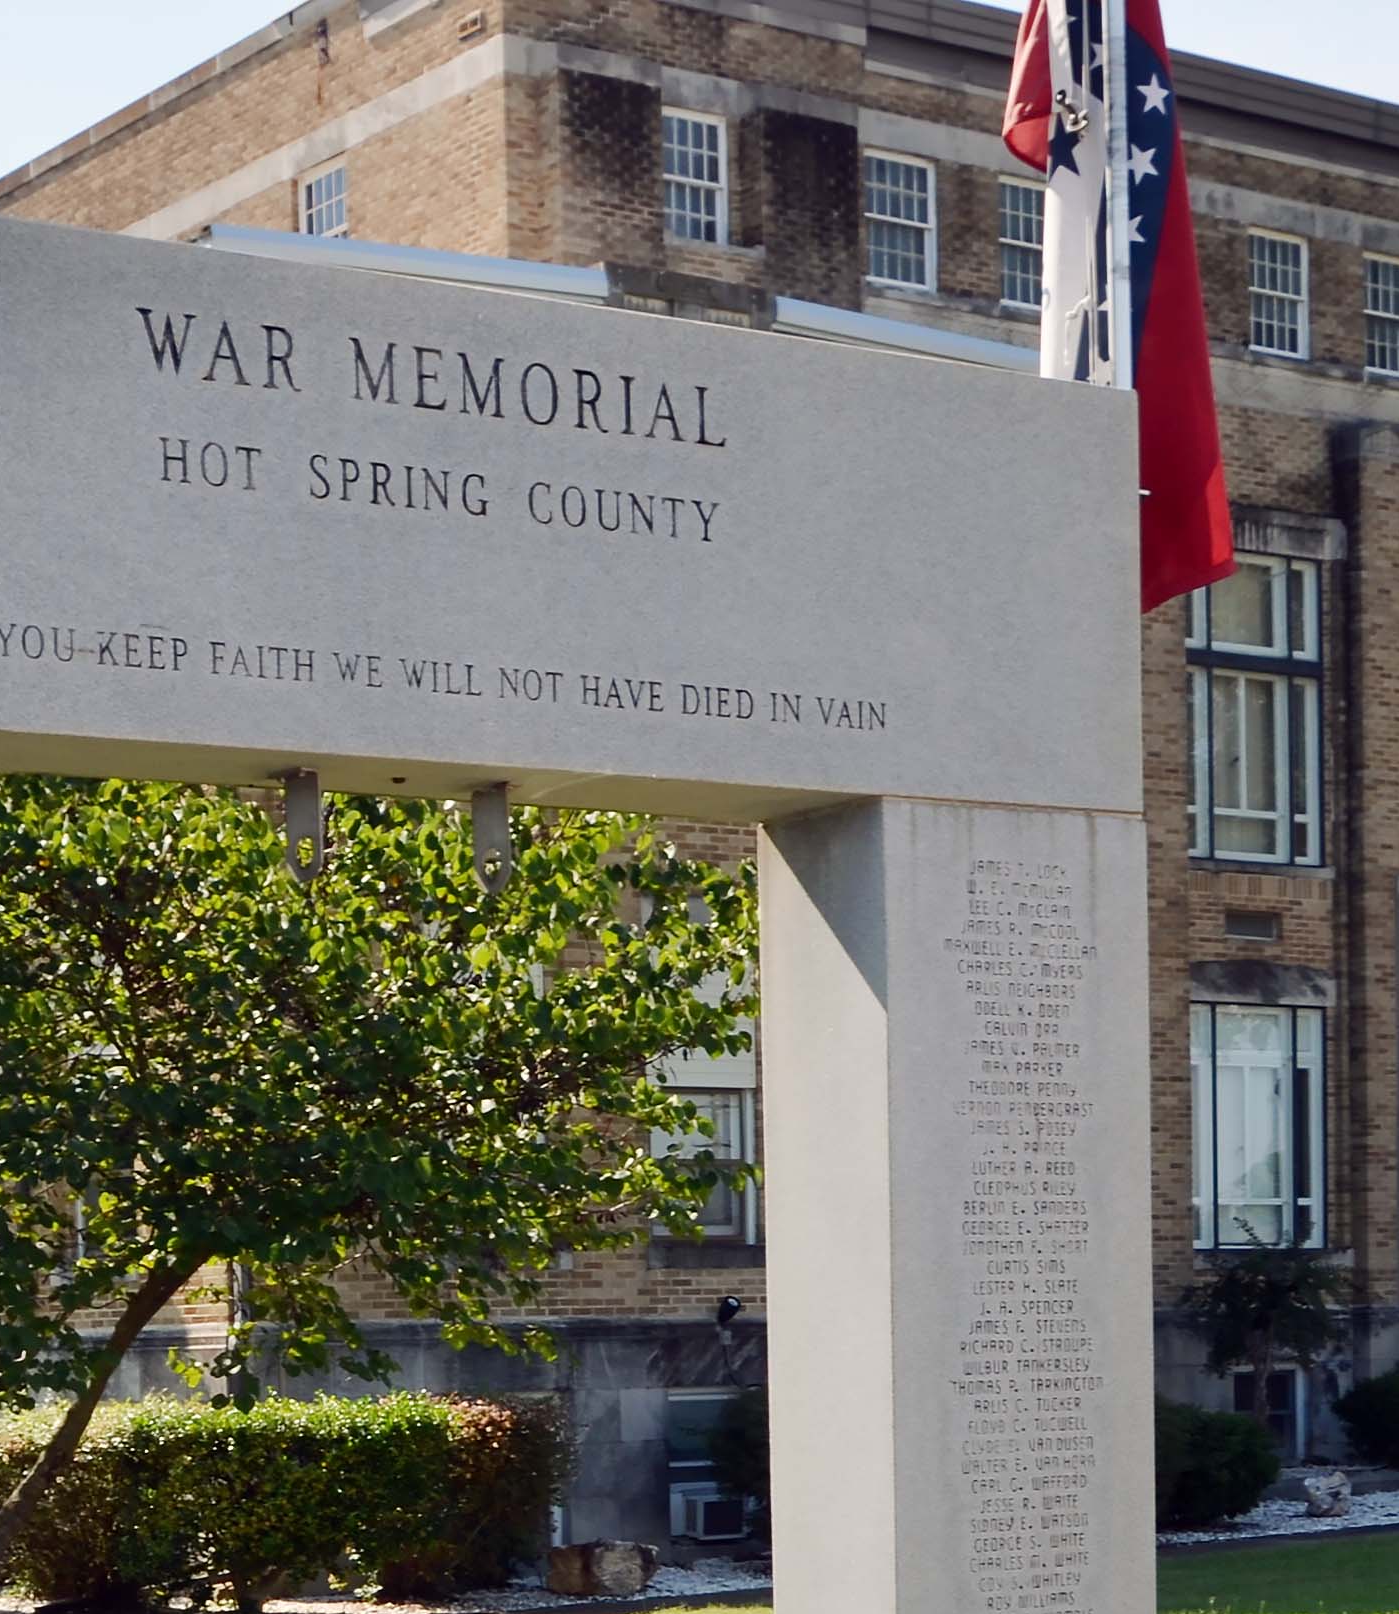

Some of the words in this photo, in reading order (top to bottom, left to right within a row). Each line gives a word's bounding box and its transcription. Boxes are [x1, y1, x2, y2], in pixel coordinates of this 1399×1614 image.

[135, 307, 301, 394] WAR
[349, 337, 728, 449] MEMORIAL
[158, 437, 261, 490] HOT
[308, 455, 488, 518] SPRING
[529, 482, 722, 542] COUNTY
[94, 630, 189, 672] KEEP
[210, 641, 315, 682] FAITH
[332, 651, 383, 688] WE
[401, 659, 483, 698] WILL
[498, 667, 565, 703] NOT
[580, 675, 665, 713] HAVE
[680, 683, 753, 721] DIED
[771, 693, 801, 724] IN
[817, 696, 887, 731] VAIN
